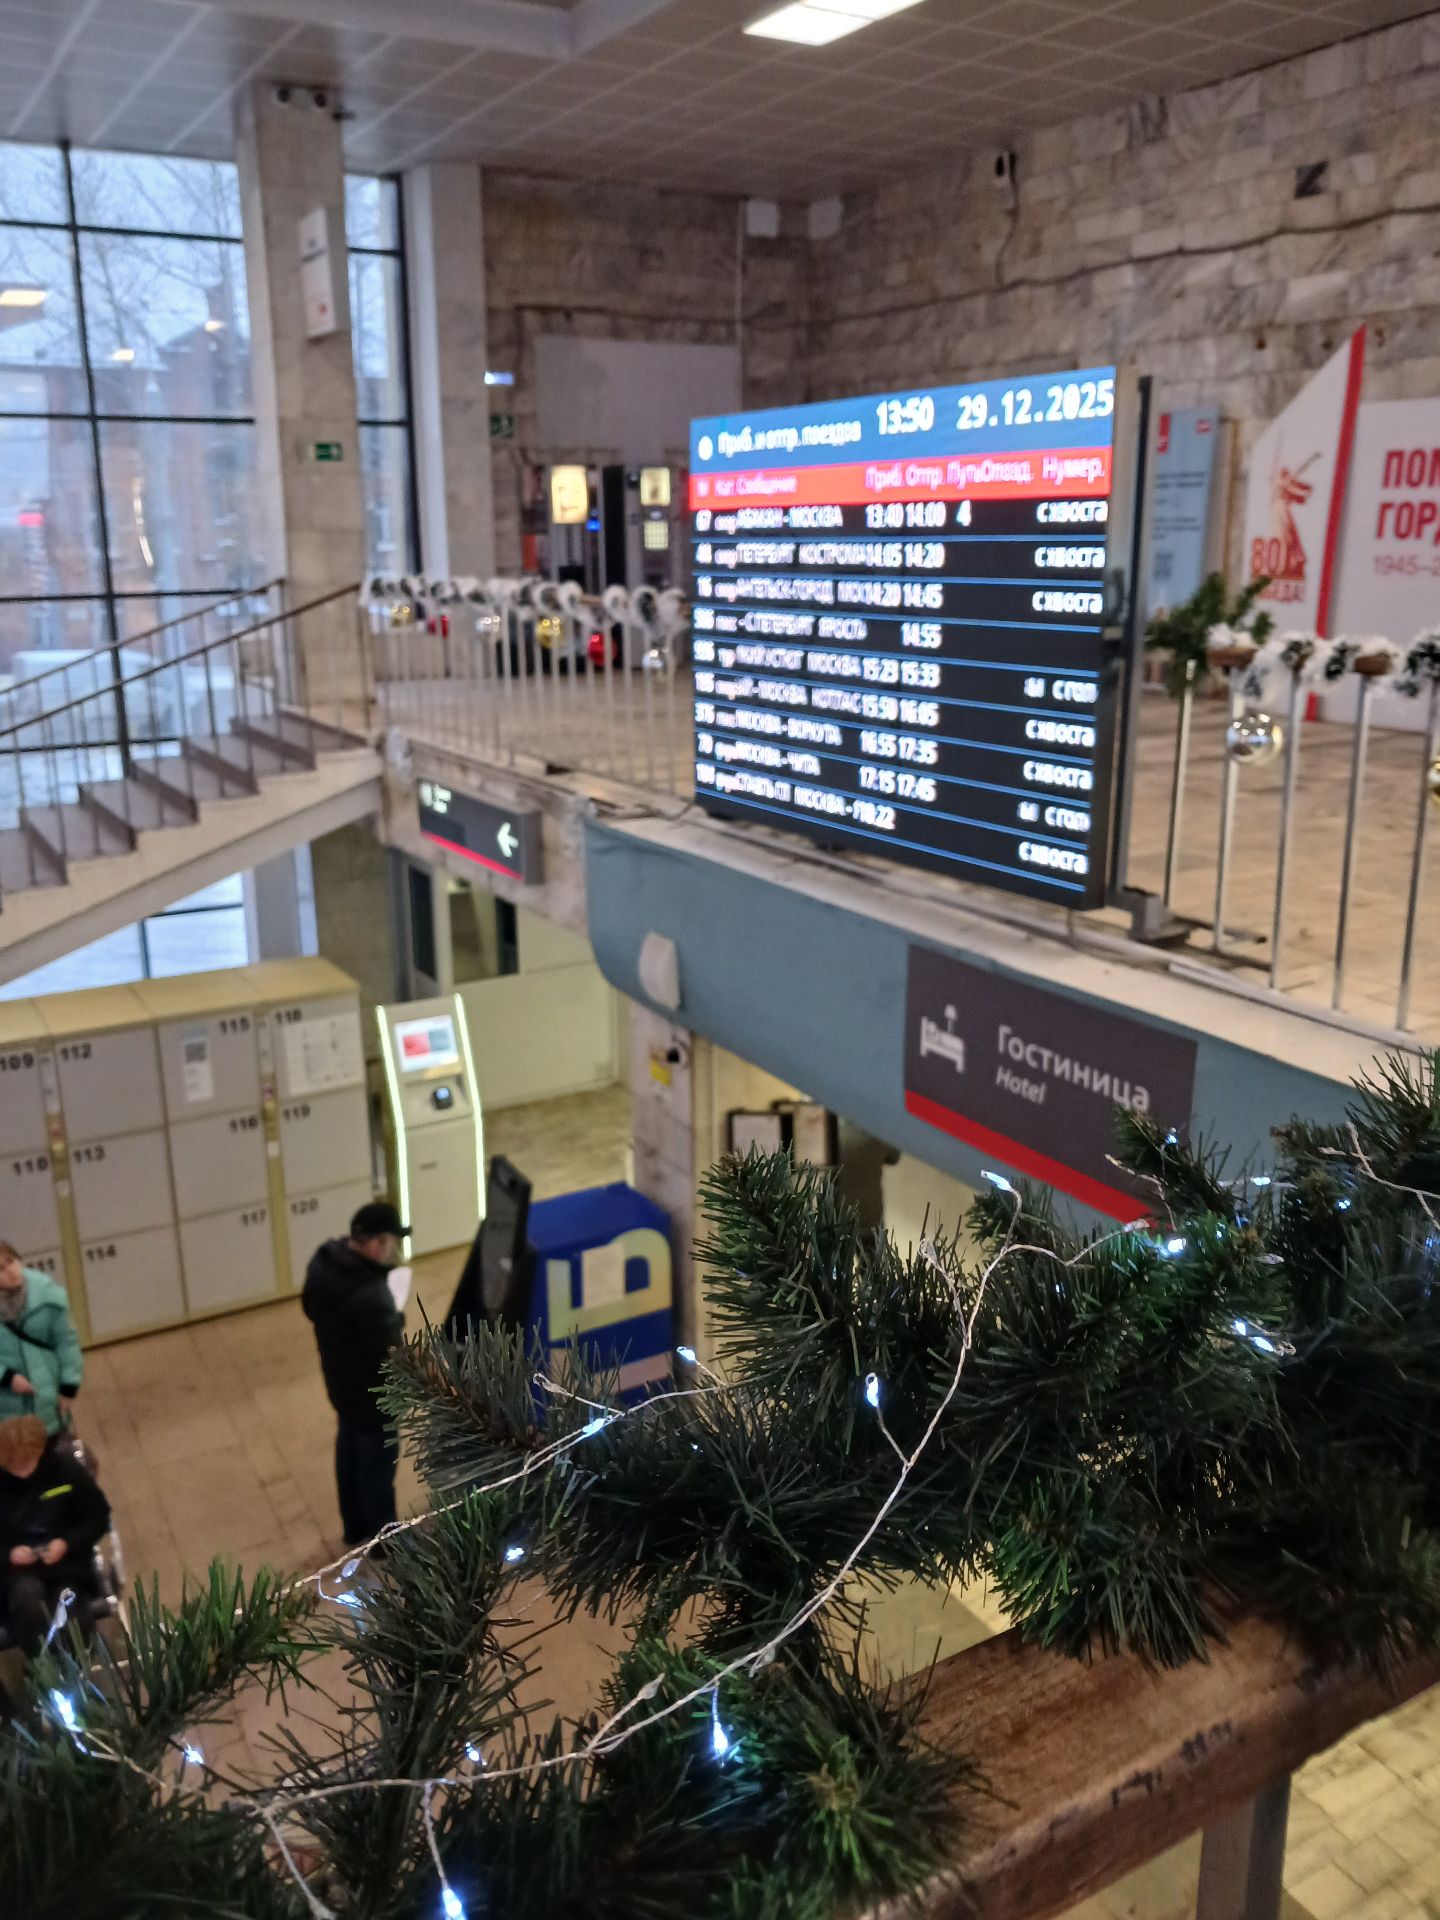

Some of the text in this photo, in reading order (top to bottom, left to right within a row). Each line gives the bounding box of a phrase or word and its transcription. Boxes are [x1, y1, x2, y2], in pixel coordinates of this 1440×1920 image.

[876, 395, 935, 436] 13:50
[956, 379, 1115, 431] 29.12.2025
[995, 1064, 1047, 1105] Hotel
[997, 1024, 1150, 1112] Гостиница
